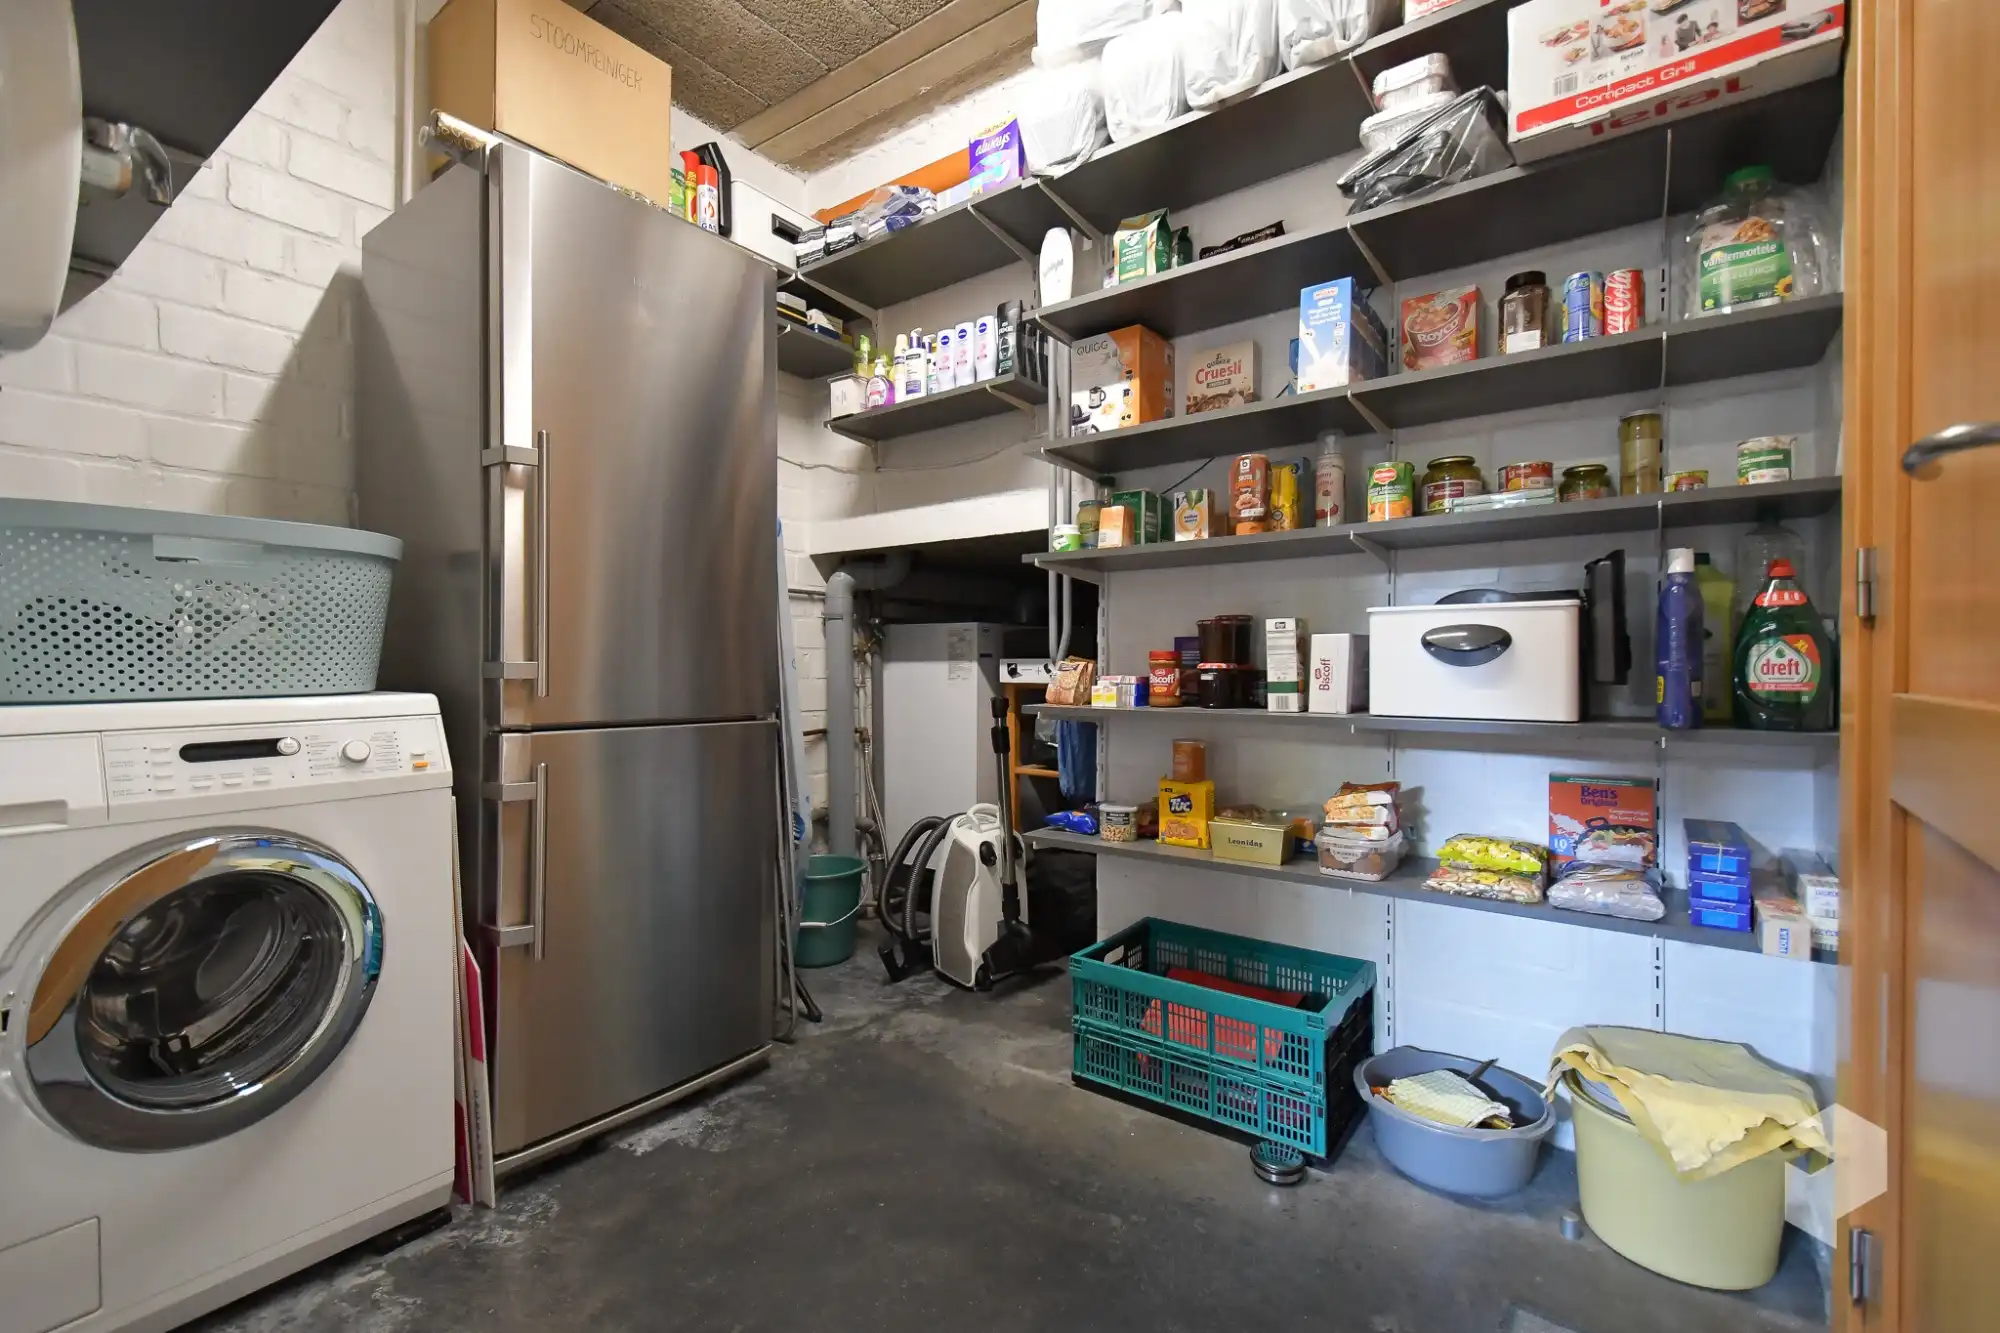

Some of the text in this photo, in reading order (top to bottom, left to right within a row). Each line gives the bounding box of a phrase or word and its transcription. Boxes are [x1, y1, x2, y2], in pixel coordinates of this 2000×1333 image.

[530, 14, 642, 93] STOOMREINIGER
[1575, 76, 1655, 109] Compact
[1660, 60, 1697, 81] Grill
[975, 132, 1011, 157] always
[1417, 319, 1459, 343] ROYCO
[1077, 340, 1109, 356] QUIGG
[1195, 359, 1242, 385] Cruesli
[1319, 658, 1331, 691] Biscoff
[1760, 659, 1801, 676] dreft
[1581, 785, 1617, 799] Ben's
[1227, 837, 1263, 848] Leonidas
[1554, 839, 1568, 850] 10
